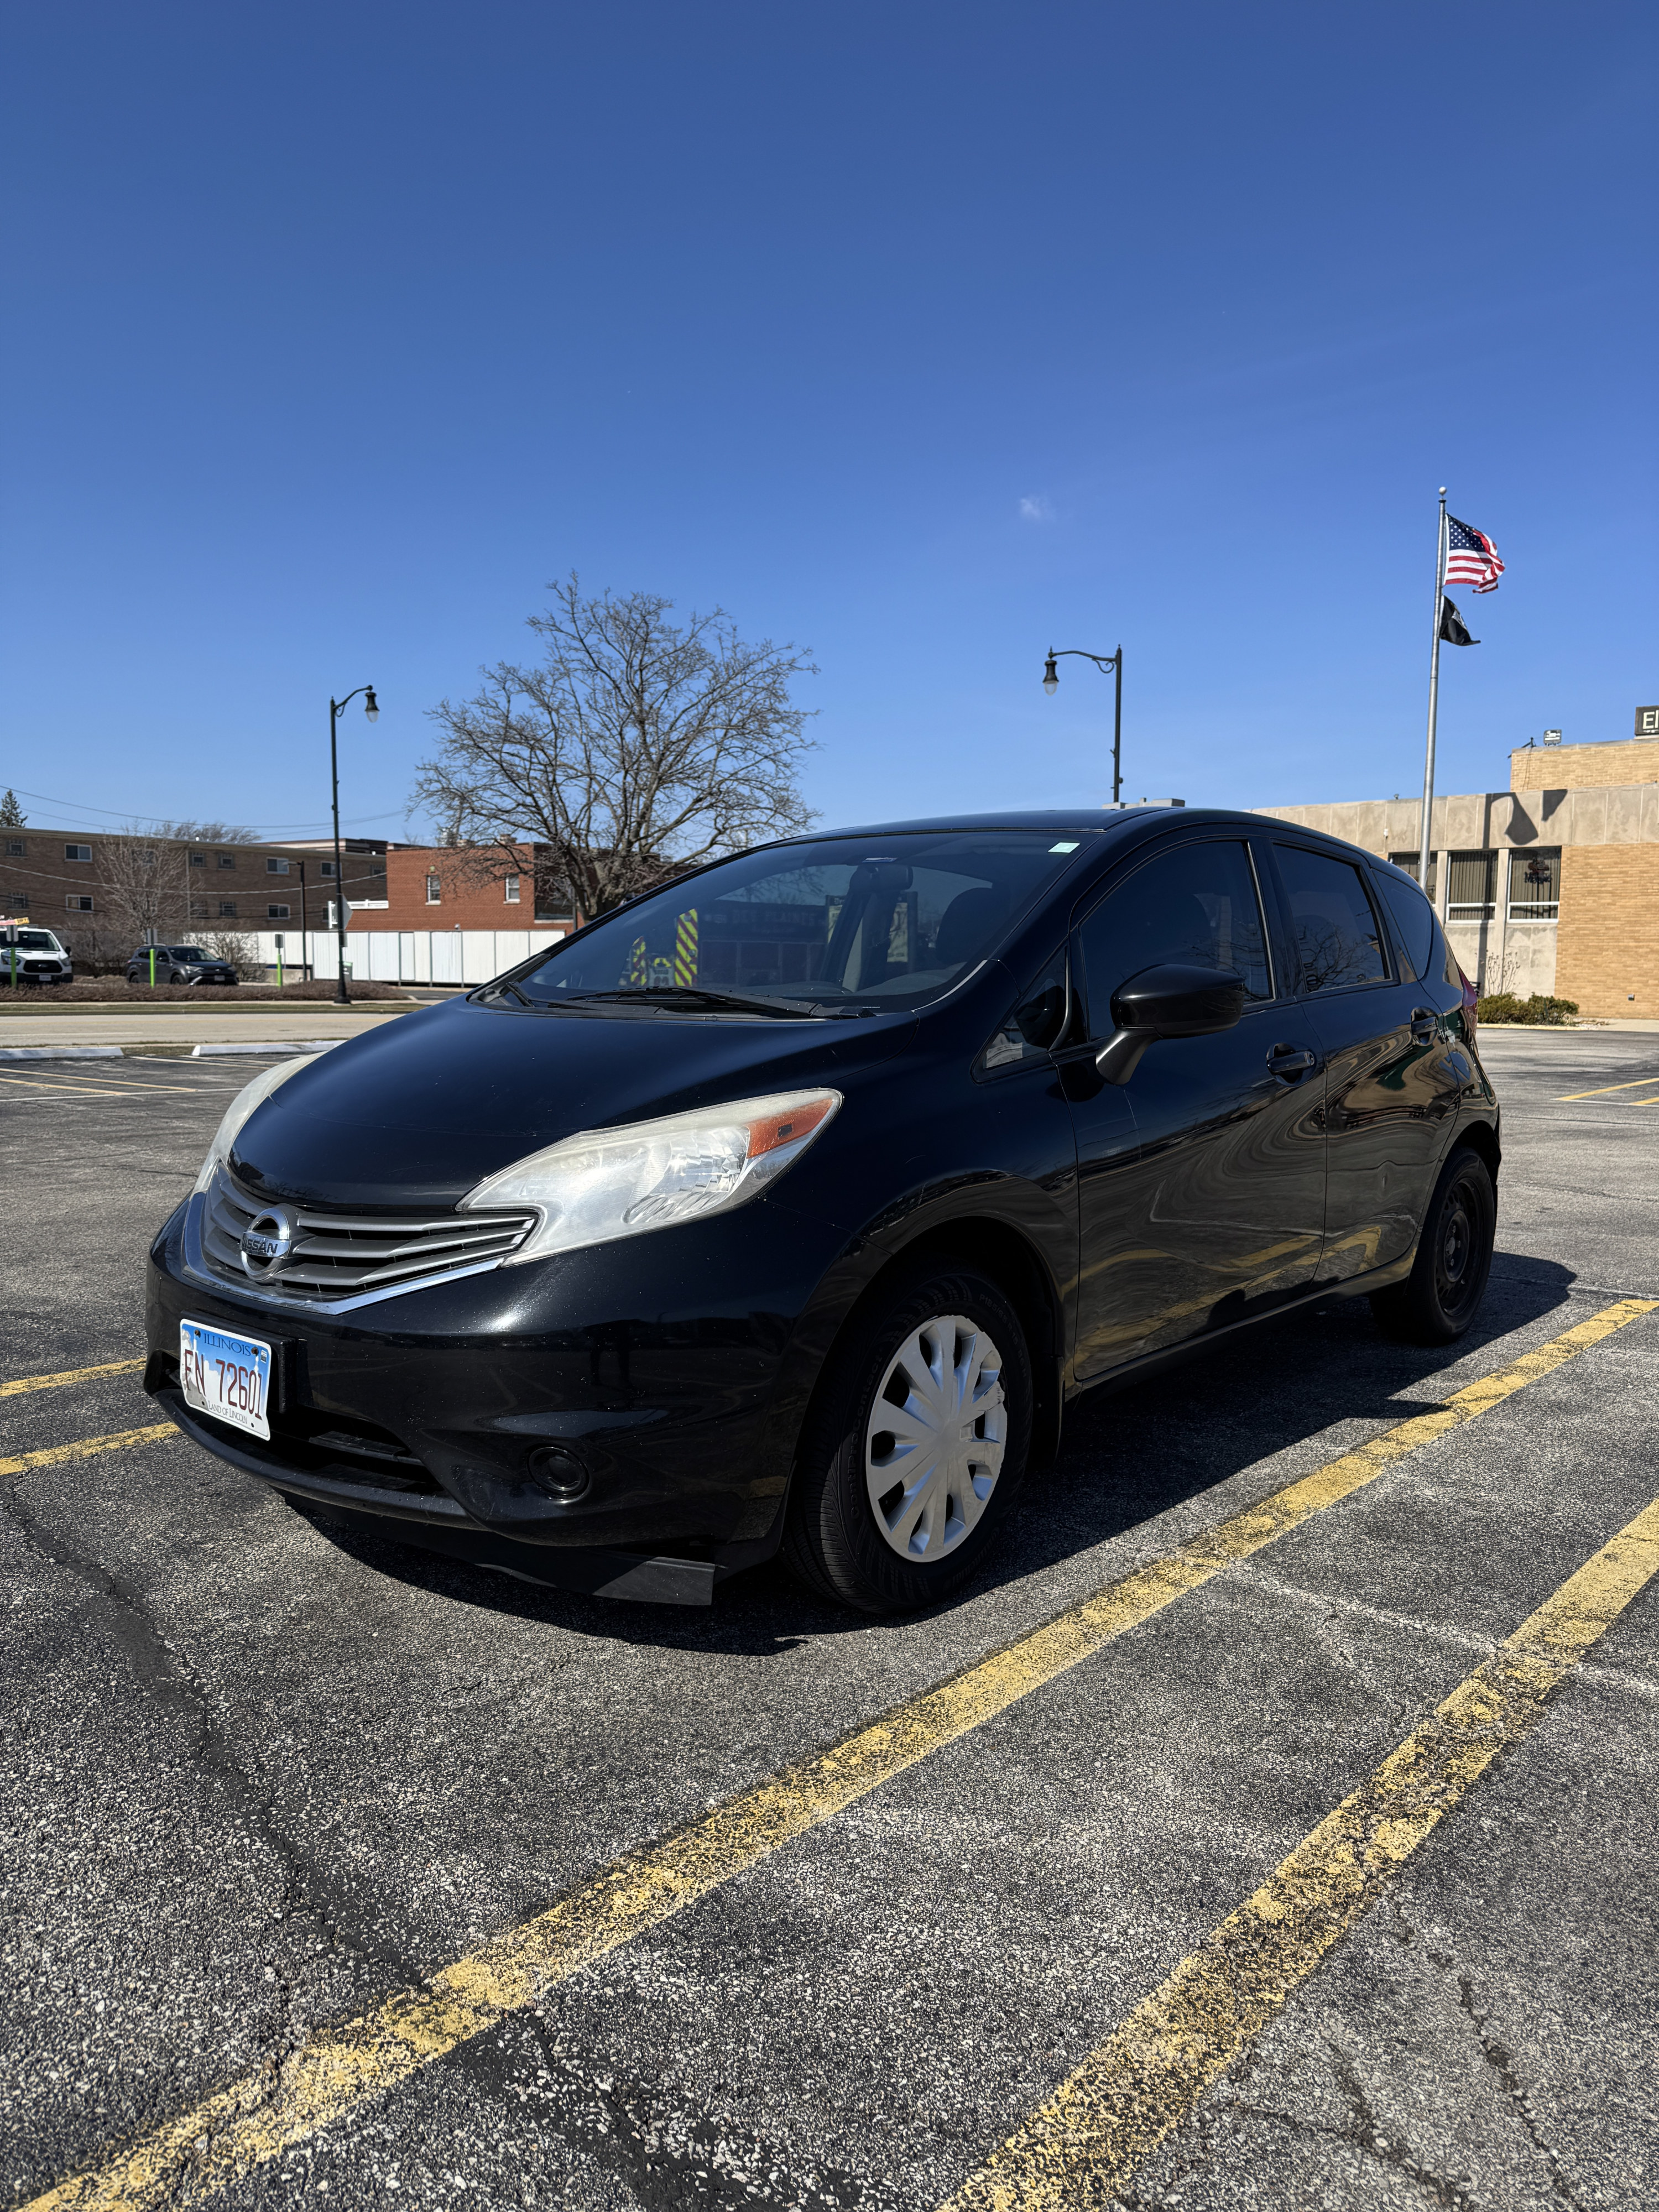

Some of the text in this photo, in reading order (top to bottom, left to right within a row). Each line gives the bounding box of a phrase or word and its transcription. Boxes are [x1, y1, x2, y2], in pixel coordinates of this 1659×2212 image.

[242, 1233, 278, 1254] NISSAN
[204, 1333, 251, 1357] ILLINOIS
[215, 1359, 263, 1421] 72601
